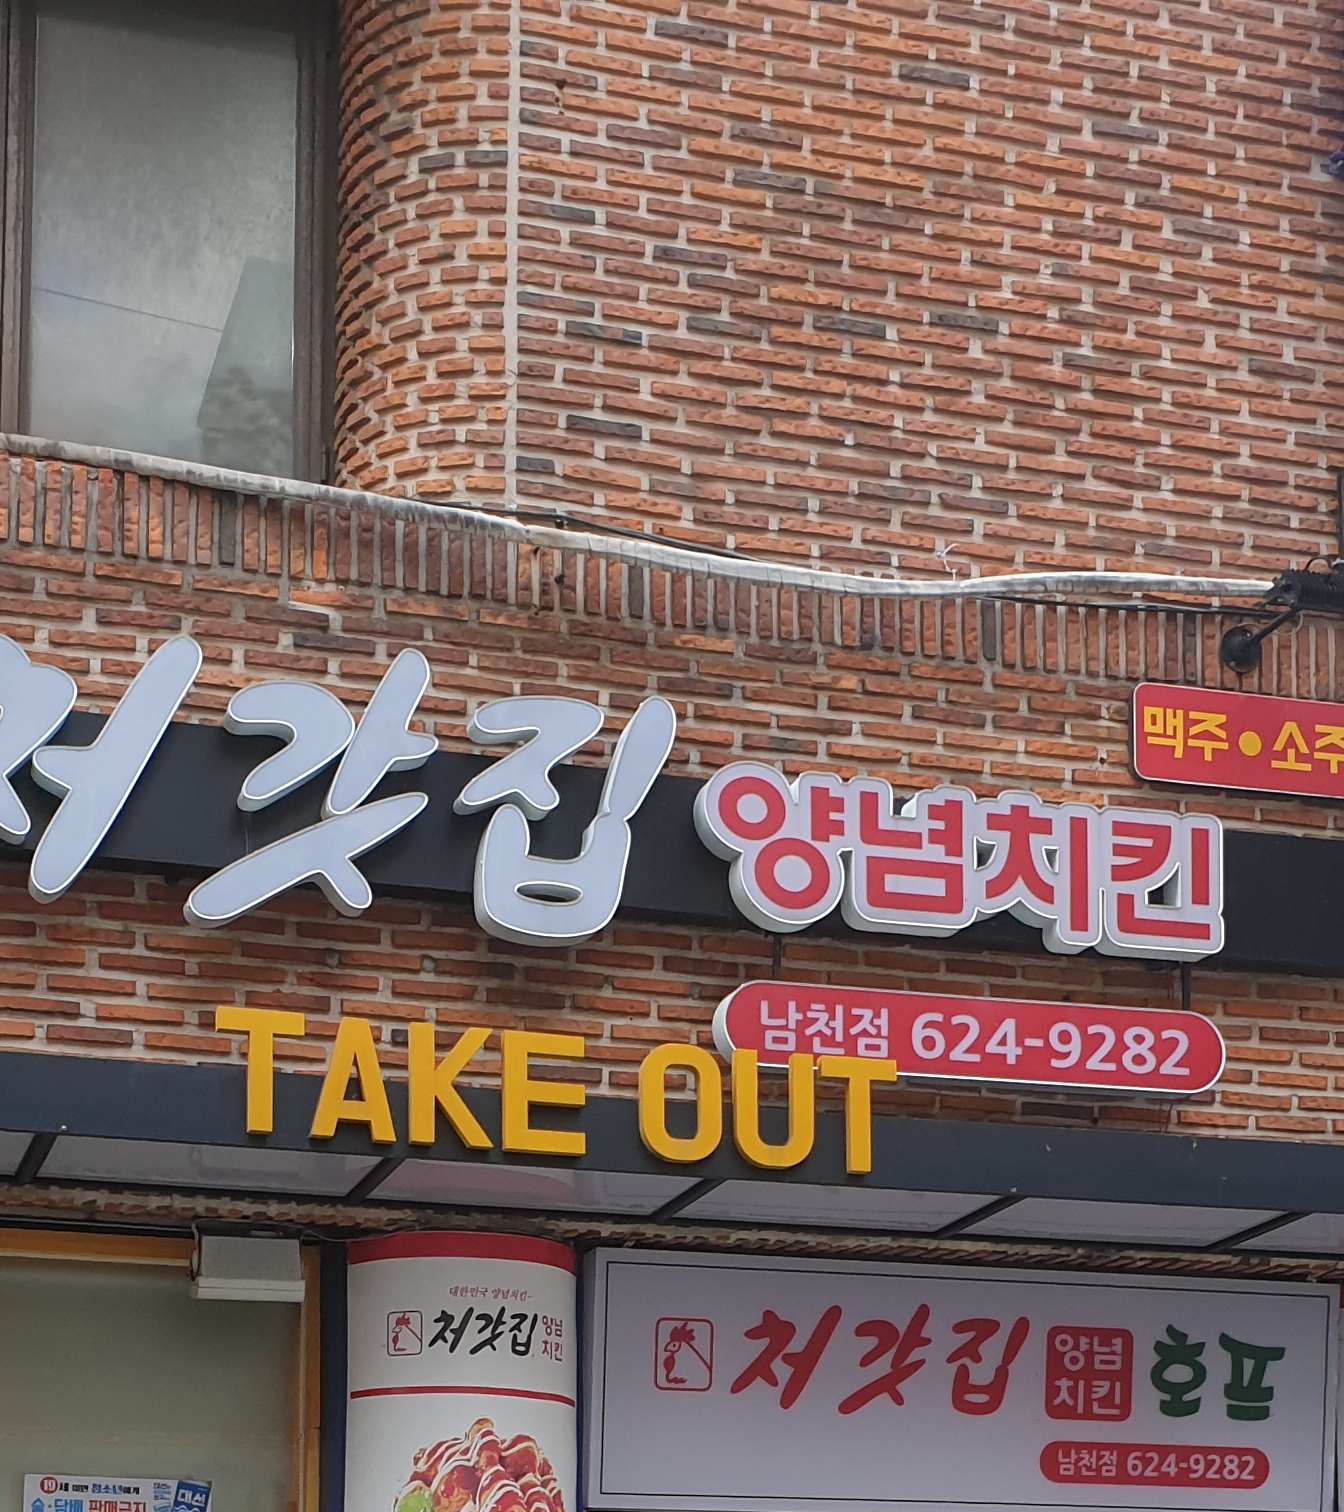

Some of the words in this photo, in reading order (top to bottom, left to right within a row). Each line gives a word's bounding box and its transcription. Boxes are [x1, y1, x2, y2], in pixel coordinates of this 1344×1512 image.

[702, 768, 1222, 955] 양념치킨
[760, 1000, 889, 1059] 남천점
[911, 1012, 1191, 1076] 624-9282
[215, 1006, 587, 1156] TAKE
[638, 1042, 898, 1175] OUT
[450, 1286, 488, 1298] 대한민국
[428, 1306, 538, 1356] 처갓집
[541, 1315, 563, 1337] 양념
[541, 1339, 563, 1361] 치킨
[729, 1303, 1030, 1416] 처갓집
[1053, 1332, 1122, 1372] 양념
[1150, 1323, 1286, 1420] 호프
[1053, 1378, 1122, 1416] 치킨
[1057, 1448, 1117, 1479] 남천점
[1126, 1451, 1256, 1481] 624-9282
[177, 1489, 206, 1507] 대선
